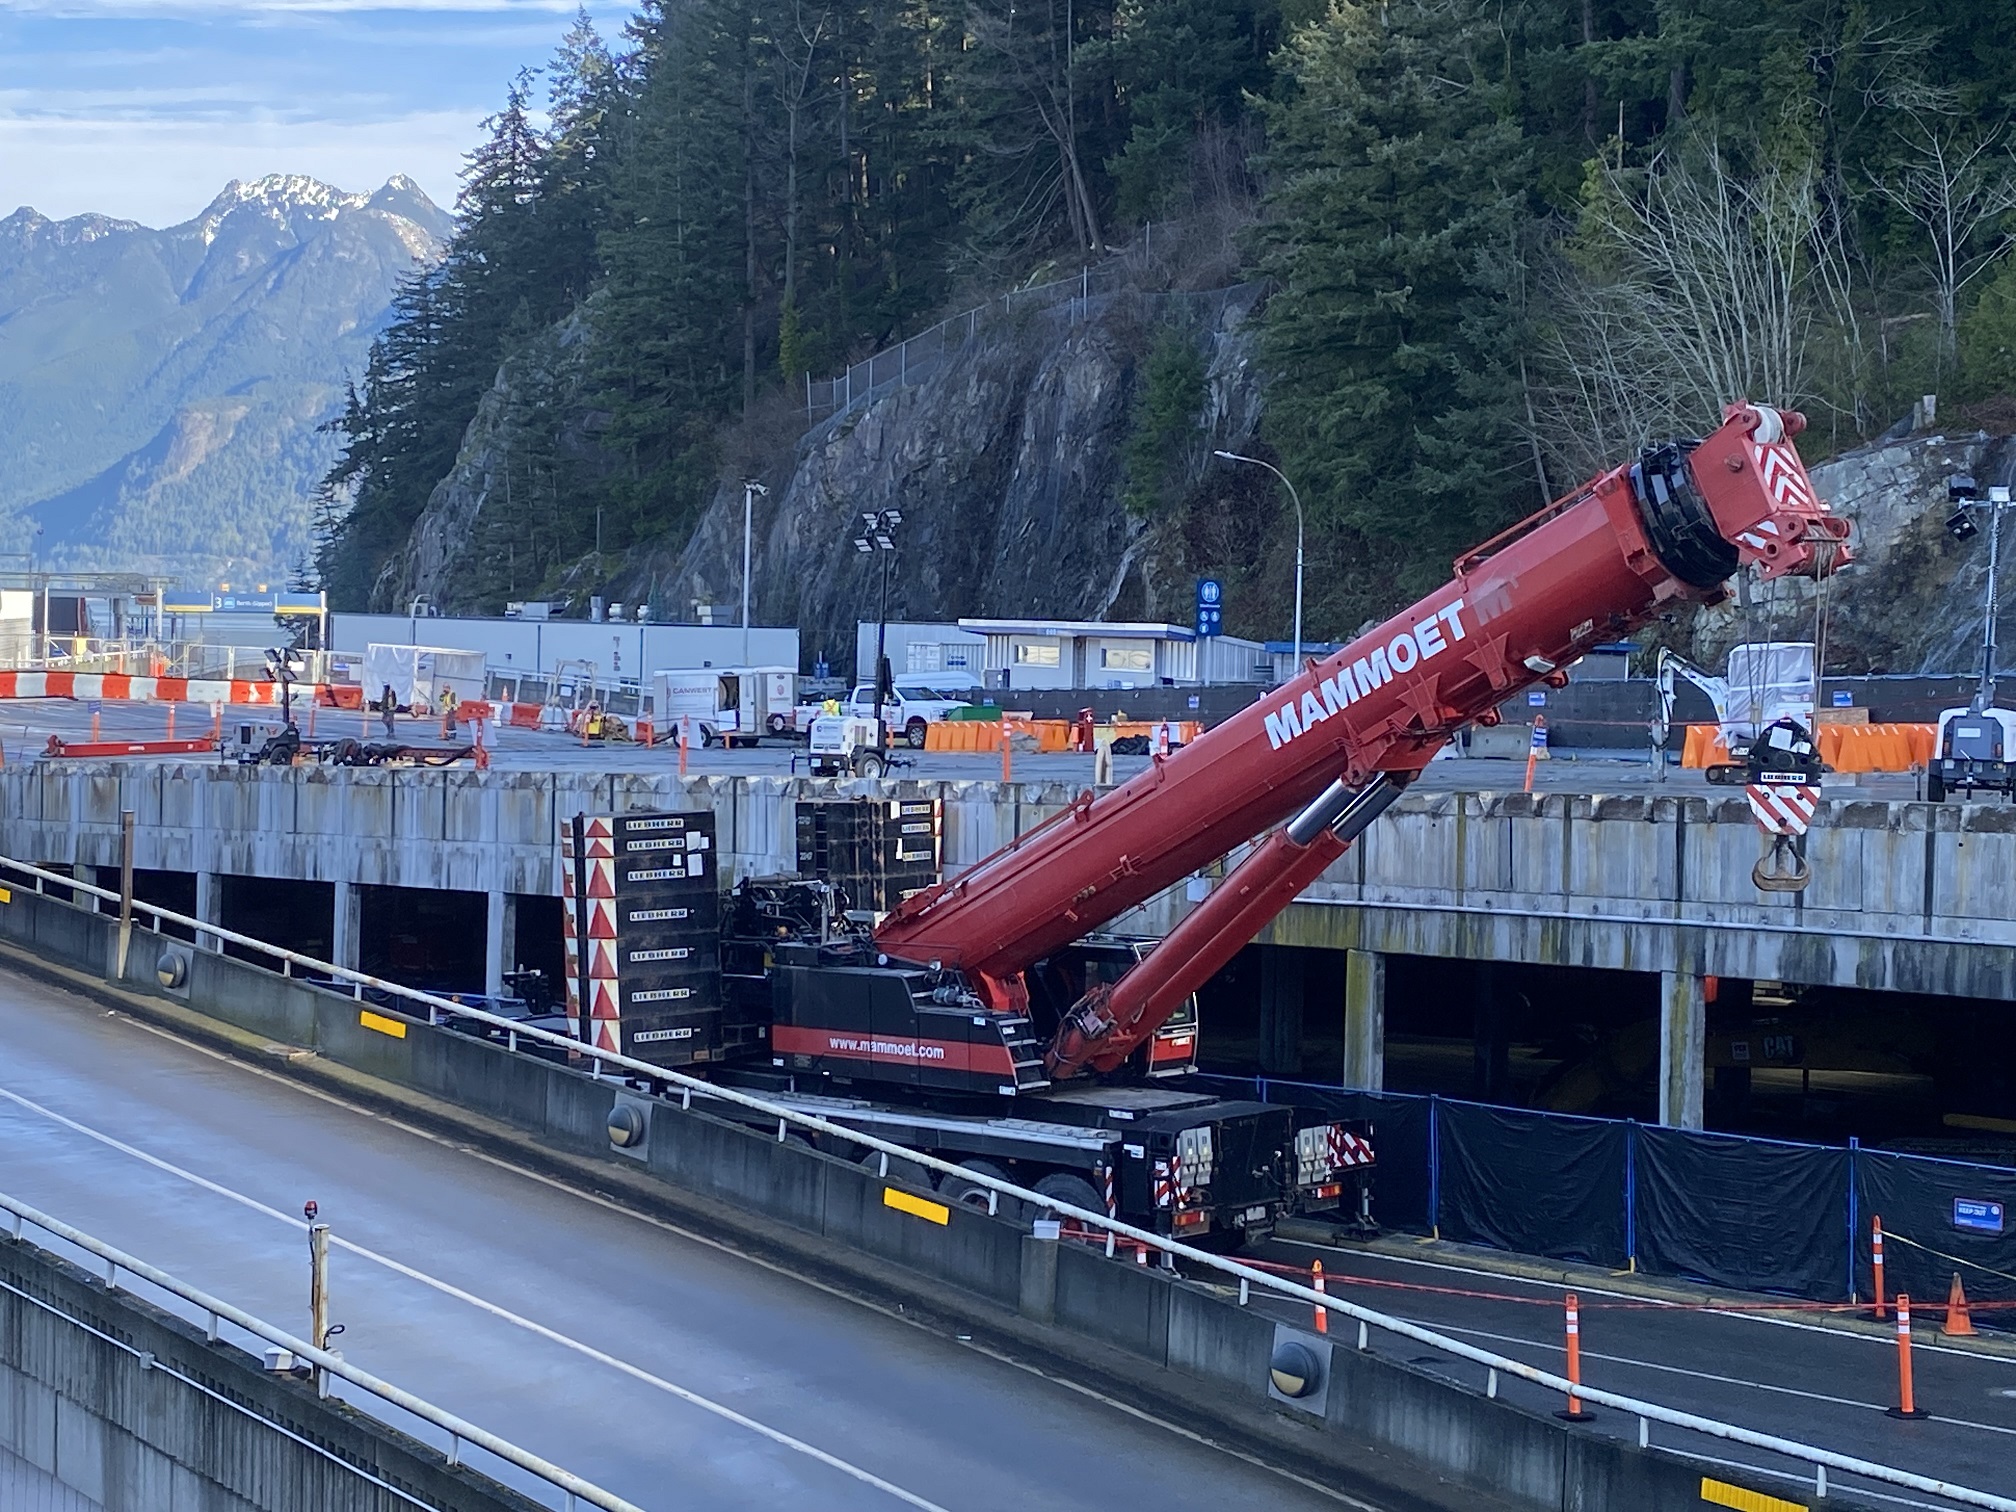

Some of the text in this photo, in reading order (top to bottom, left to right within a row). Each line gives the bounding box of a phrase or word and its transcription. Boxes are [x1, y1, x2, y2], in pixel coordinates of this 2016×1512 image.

[214, 596, 223, 609] 3
[1264, 598, 1466, 751] MAMMOET
[672, 687, 712, 695] CANWEST
[1762, 773, 1805, 782] LIEBHERR
[627, 819, 682, 829] LIEBHERR
[628, 839, 683, 849] LIEBHERR
[629, 869, 684, 880] LIEBHERR
[631, 910, 686, 920] LIEBHERR
[631, 950, 686, 960] LIEBHERR
[633, 989, 688, 1001] LIEBHERR
[635, 1030, 690, 1042] LIEBHERR
[829, 1037, 945, 1060] www.mammoet.com
[1763, 1034, 1794, 1059] CAT
